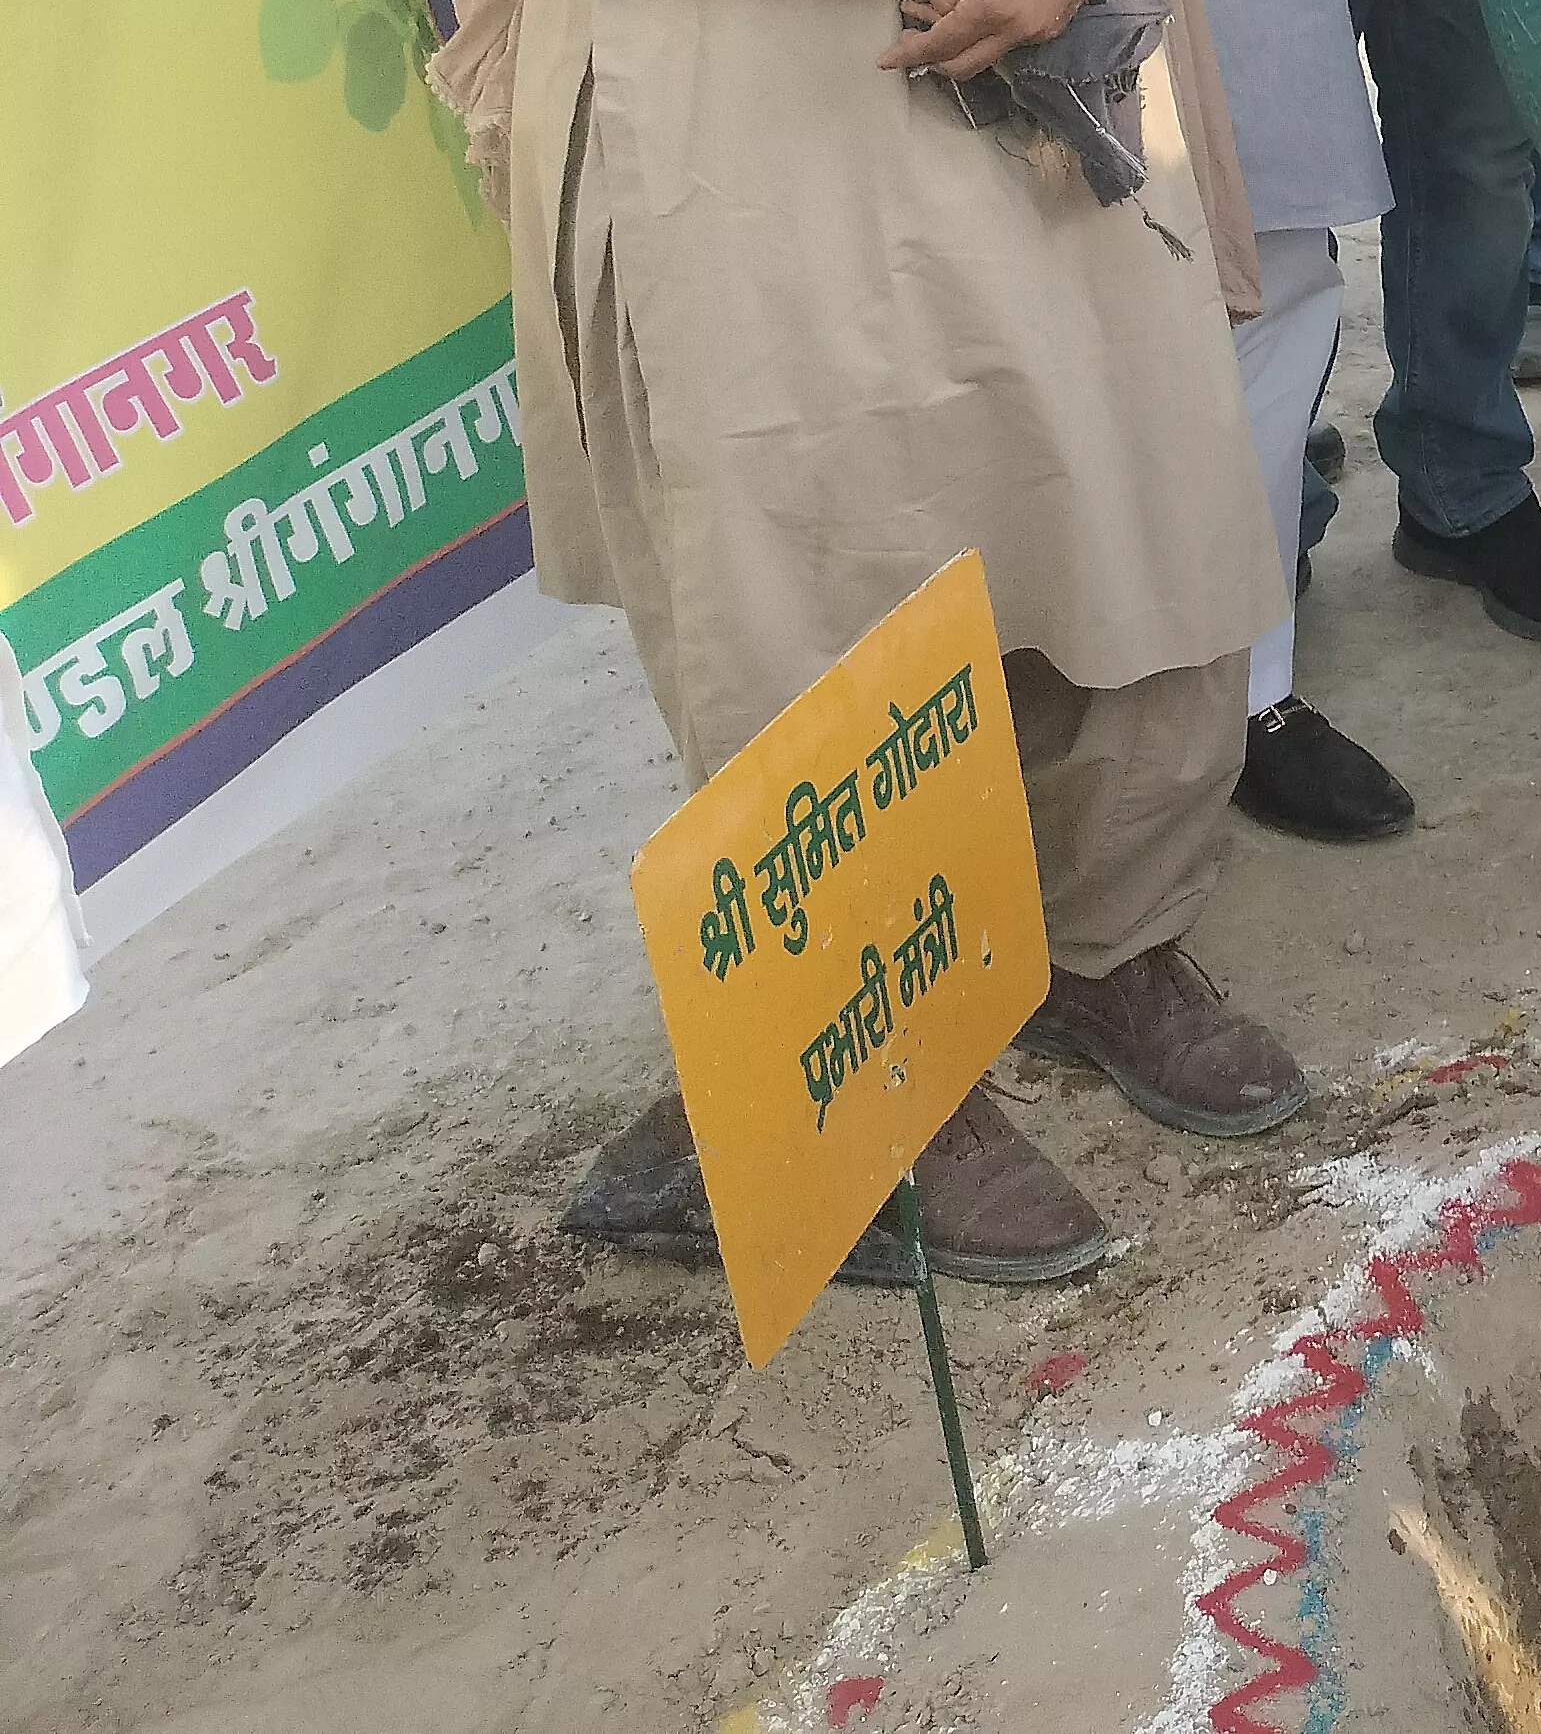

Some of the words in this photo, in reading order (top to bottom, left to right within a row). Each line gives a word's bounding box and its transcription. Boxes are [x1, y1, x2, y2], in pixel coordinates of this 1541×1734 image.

[200, 358, 523, 631] श्रीगंगानग
[700, 857, 756, 982] श्री
[754, 769, 867, 955] सुमित
[866, 662, 978, 810] गोदारा
[800, 943, 895, 1134] प्रभारी
[893, 872, 959, 1008] मंत्री
